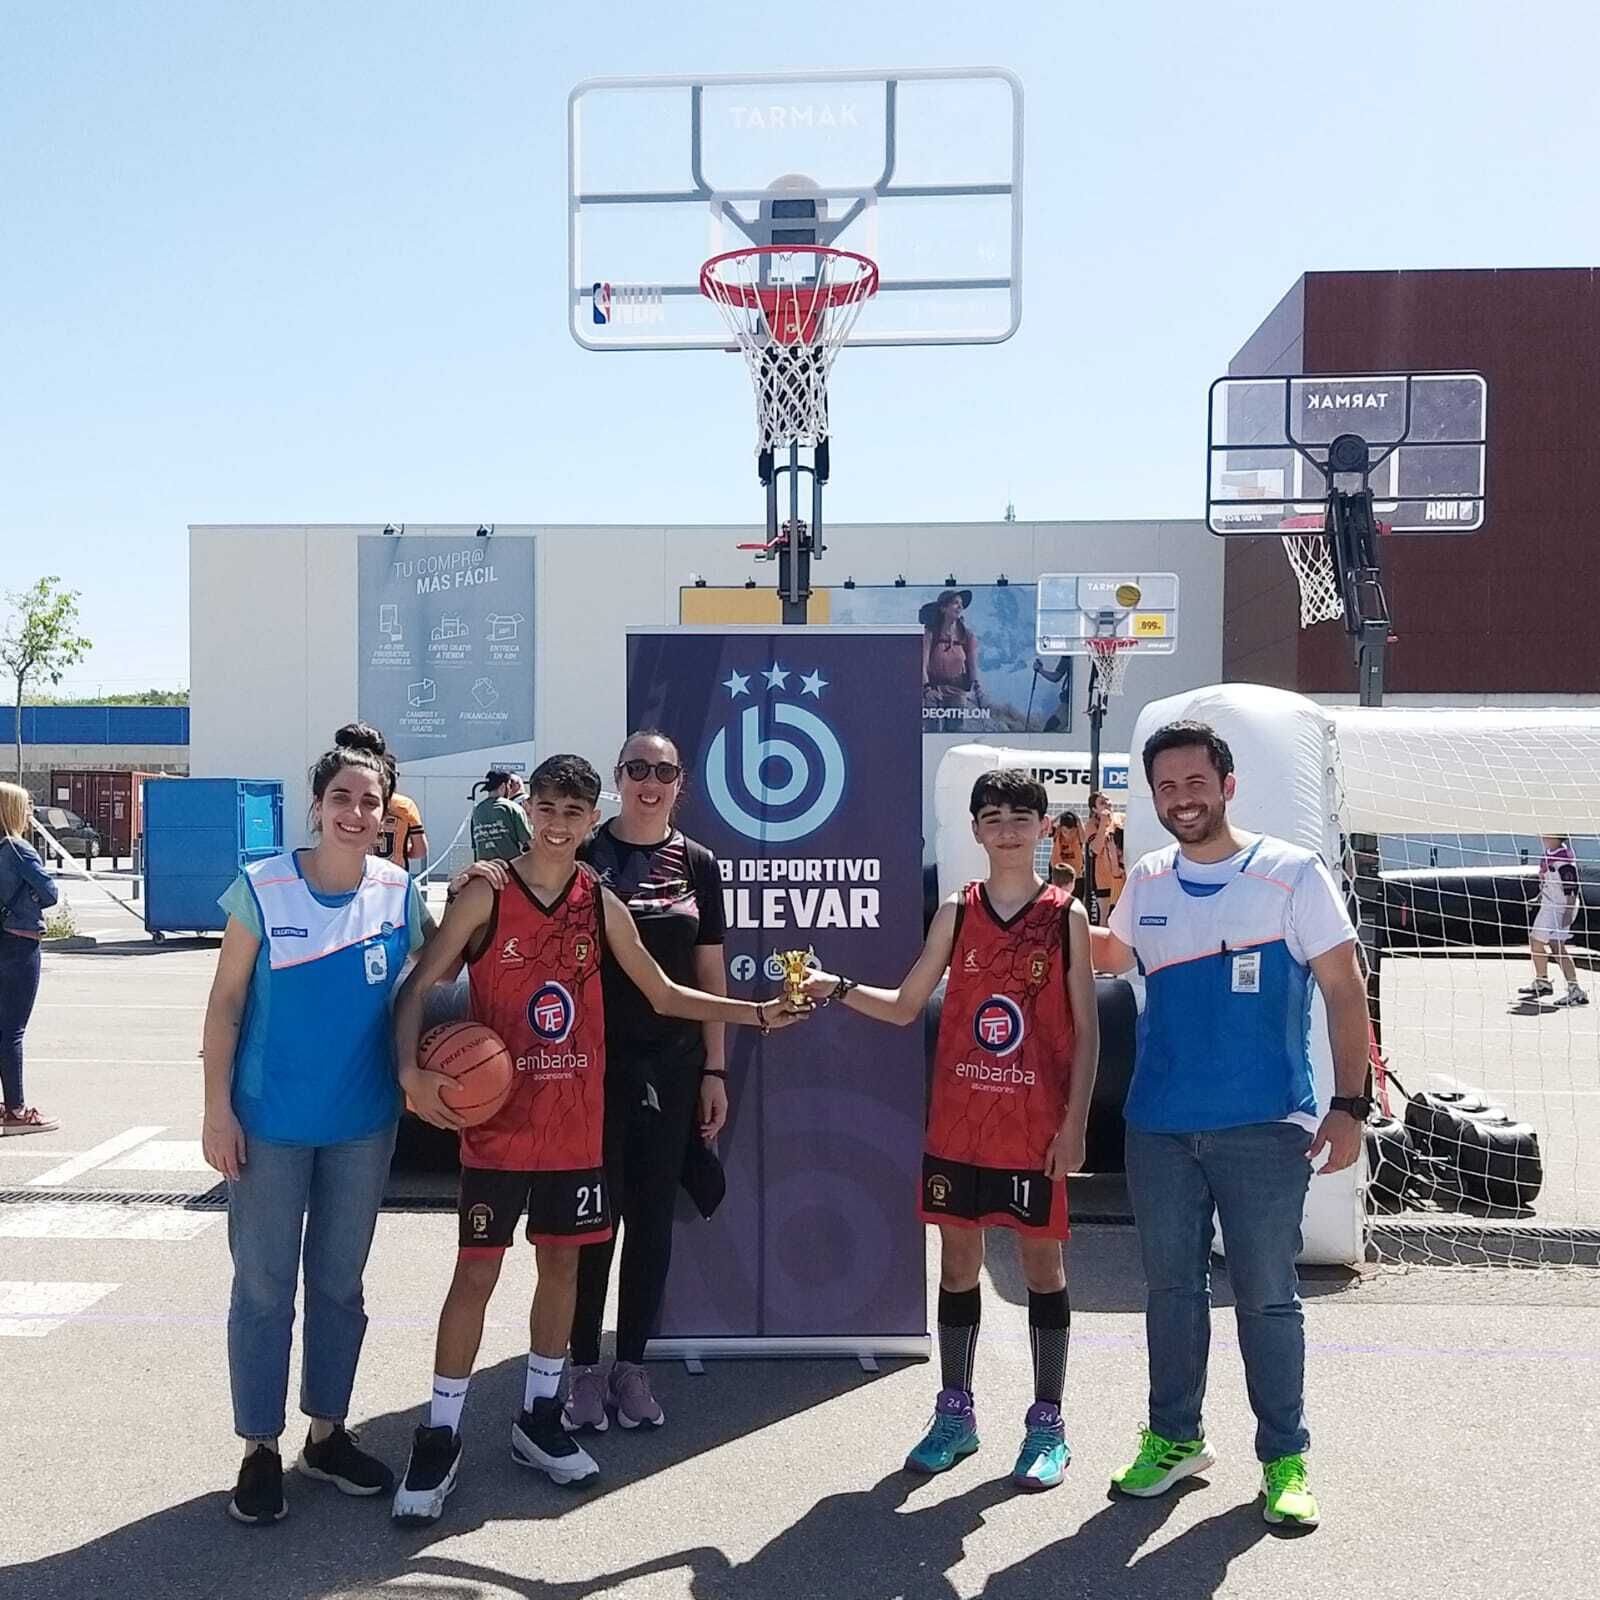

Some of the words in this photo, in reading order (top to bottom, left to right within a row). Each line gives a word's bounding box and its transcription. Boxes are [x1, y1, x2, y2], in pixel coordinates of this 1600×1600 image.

[729, 105, 859, 129] TARMAK
[393, 561, 413, 577] TU
[417, 548, 485, 572] COMPR@
[416, 572, 451, 594] MÁS
[455, 566, 498, 588] FÁCIL
[922, 707, 991, 719] DECATHLON
[739, 859, 880, 882] DEPORTIVO
[516, 1049, 588, 1071] embarba
[955, 1060, 1036, 1085] embarba
[971, 1082, 1015, 1094] ascensores
[576, 1184, 602, 1217] 21
[1011, 1175, 1030, 1209] 11
[947, 1398, 961, 1409] 24
[1039, 1411, 1052, 1422] 24
